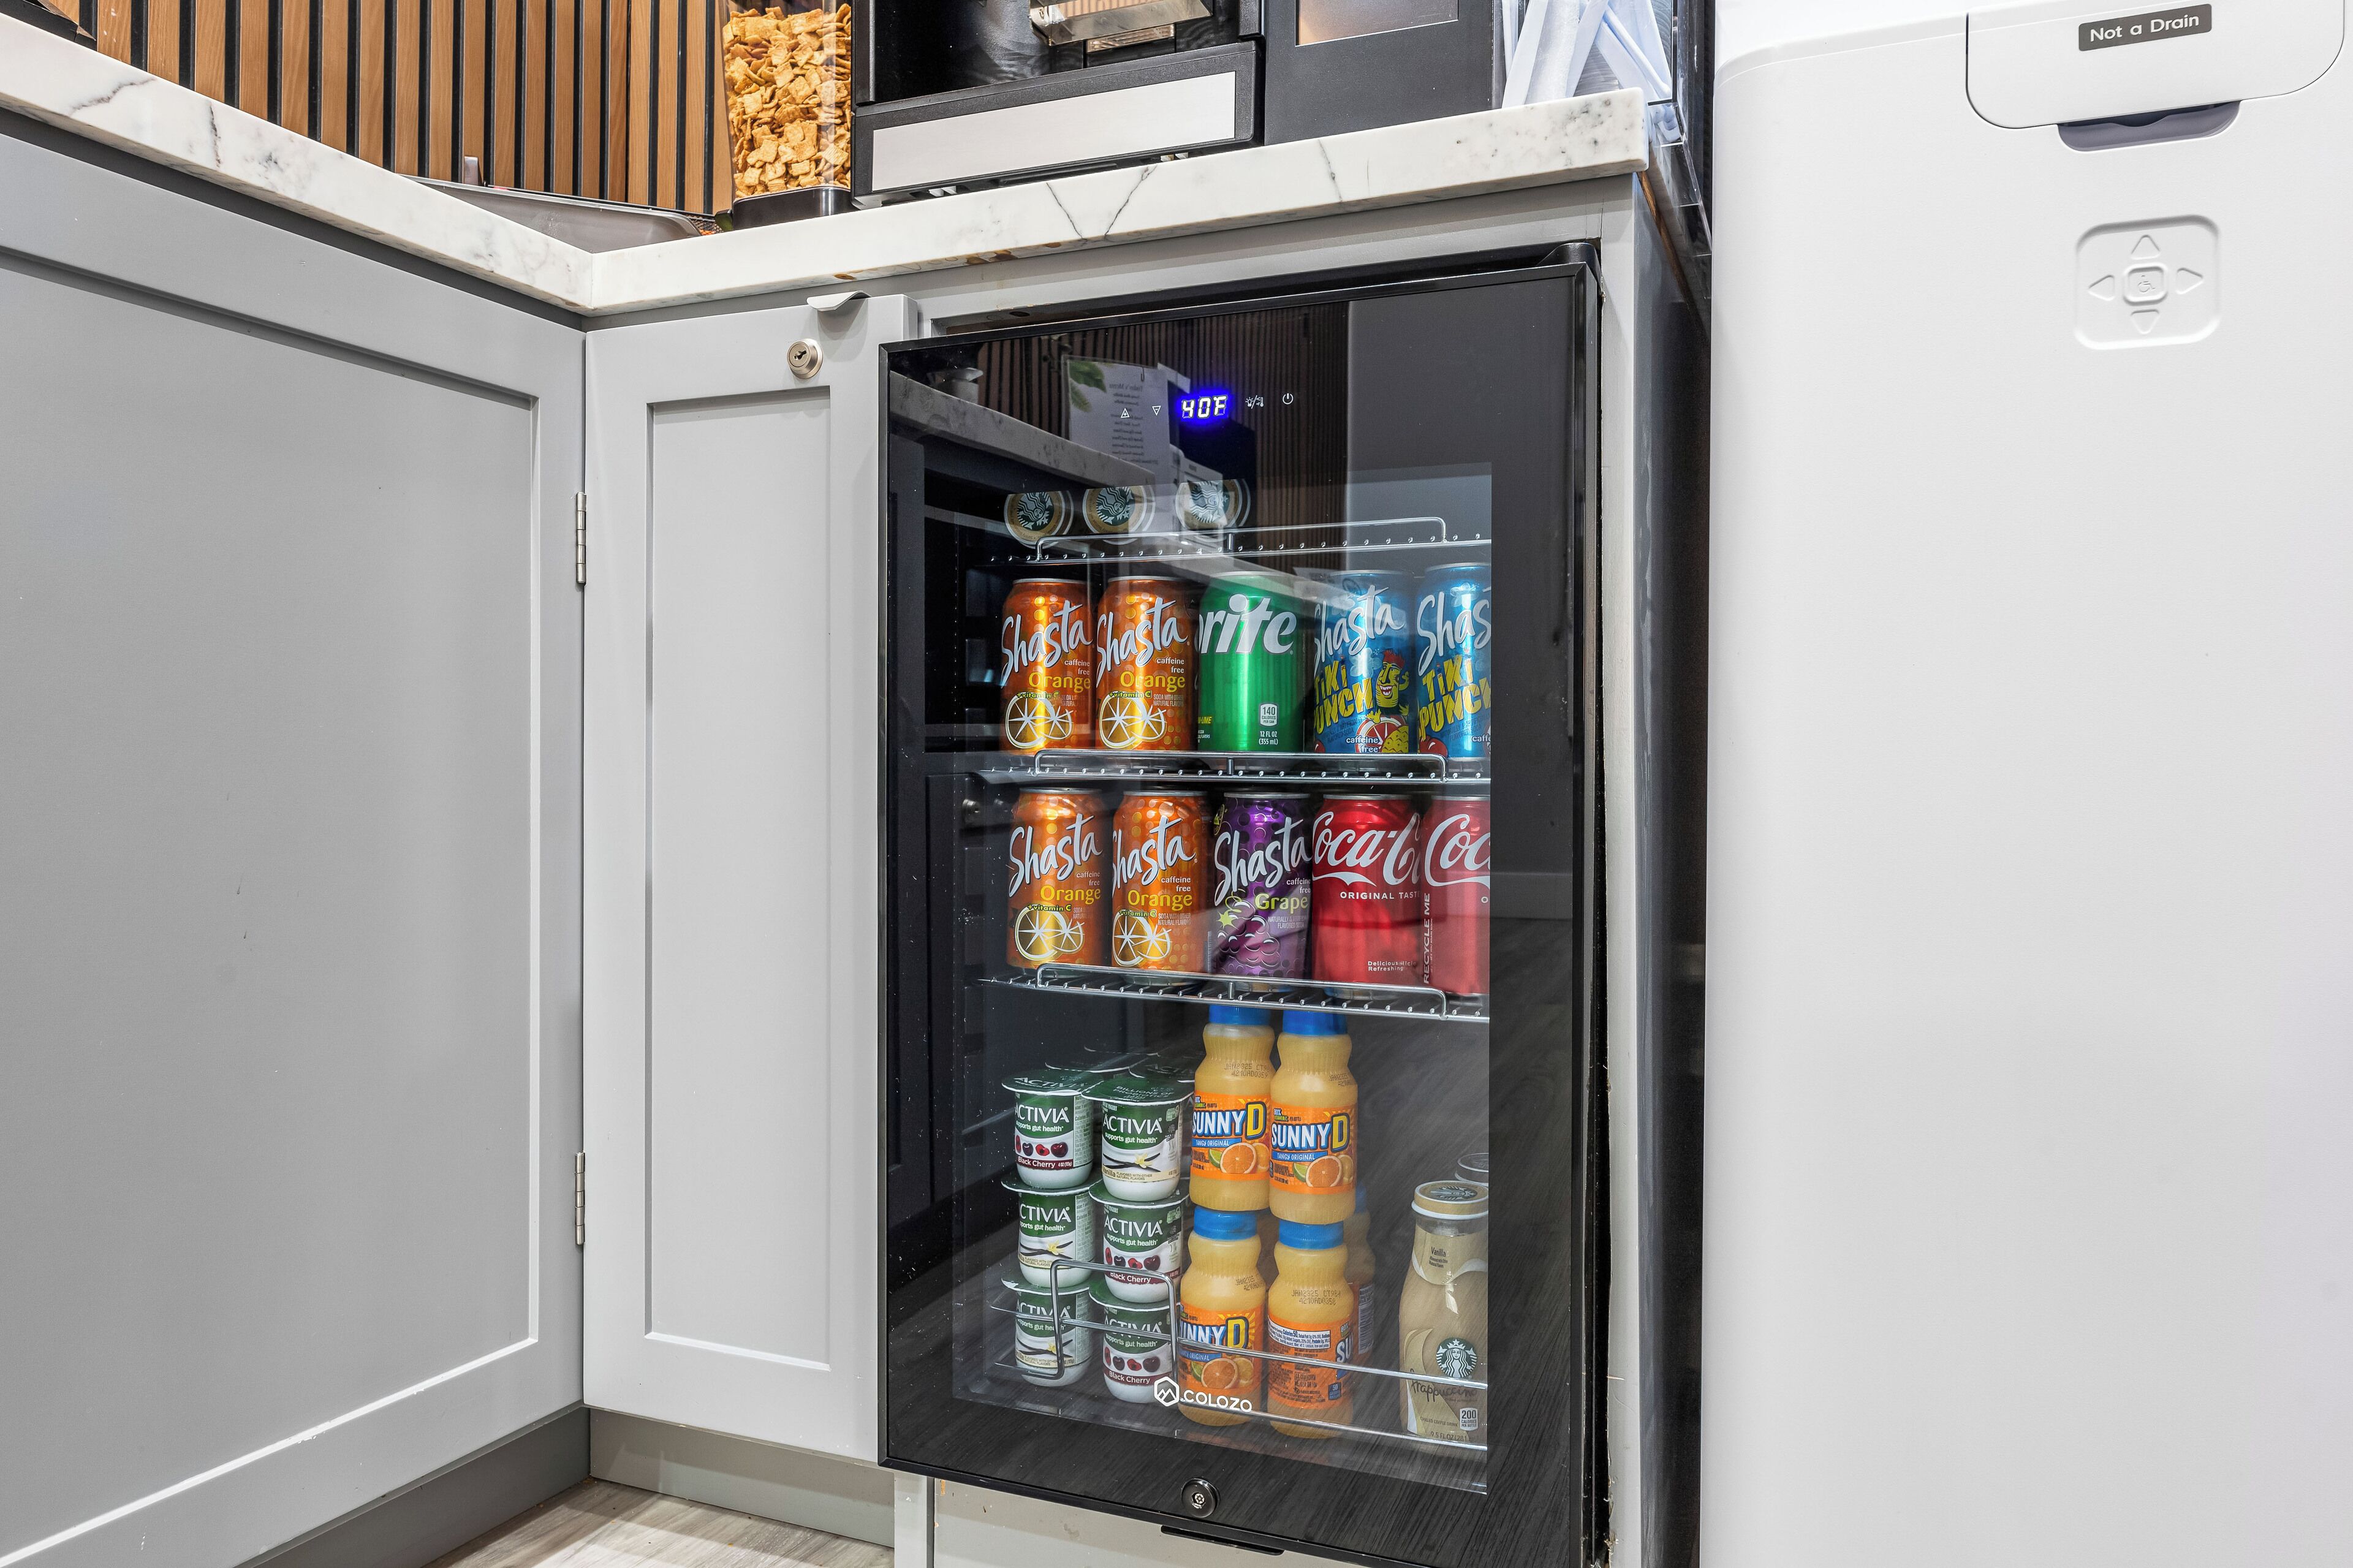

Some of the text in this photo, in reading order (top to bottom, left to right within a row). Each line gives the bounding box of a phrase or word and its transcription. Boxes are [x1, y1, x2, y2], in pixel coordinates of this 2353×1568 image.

[2090, 14, 2200, 42] Not a Drain
[1199, 593, 1297, 654] rite
[1417, 587, 1491, 676] Shas
[1001, 599, 1094, 689] Shasta
[1096, 597, 1188, 689] Shasta
[1028, 672, 1091, 693] Orange
[1120, 671, 1186, 693] Orange
[1262, 706, 1275, 716] 140
[1314, 677, 1374, 734] UNCH
[1009, 812, 1103, 898] Shasta
[1214, 816, 1313, 906] Shasta
[1040, 884, 1101, 904] Orange
[1127, 890, 1192, 911] Orange
[1255, 893, 1308, 914] Grape
[1424, 893, 1430, 915] ME
[1015, 1103, 1070, 1124] ACTIVIA
[1103, 1113, 1162, 1135] ACTIVIA
[1192, 1103, 1265, 1137] SUNNYD
[1105, 1132, 1124, 1142] supports
[1271, 1115, 1348, 1149] SUNNYD
[1018, 1156, 1056, 1169] Black Cherry
[1020, 1203, 1072, 1223] CTIVIA
[1104, 1214, 1163, 1237] ACTIVIA
[1107, 1233, 1125, 1244] supports
[1431, 1246, 1446, 1257] Vanilla
[1110, 1271, 1151, 1284] Black Cherry
[1017, 1298, 1071, 1319] ACTIVA
[1017, 1319, 1034, 1328] upports
[1180, 1319, 1246, 1349] UNNYD
[1105, 1333, 1124, 1346] supports
[1109, 1371, 1125, 1380] Black
[1183, 1389, 1252, 1412] COLOZO
[1461, 1410, 1477, 1419] 200
